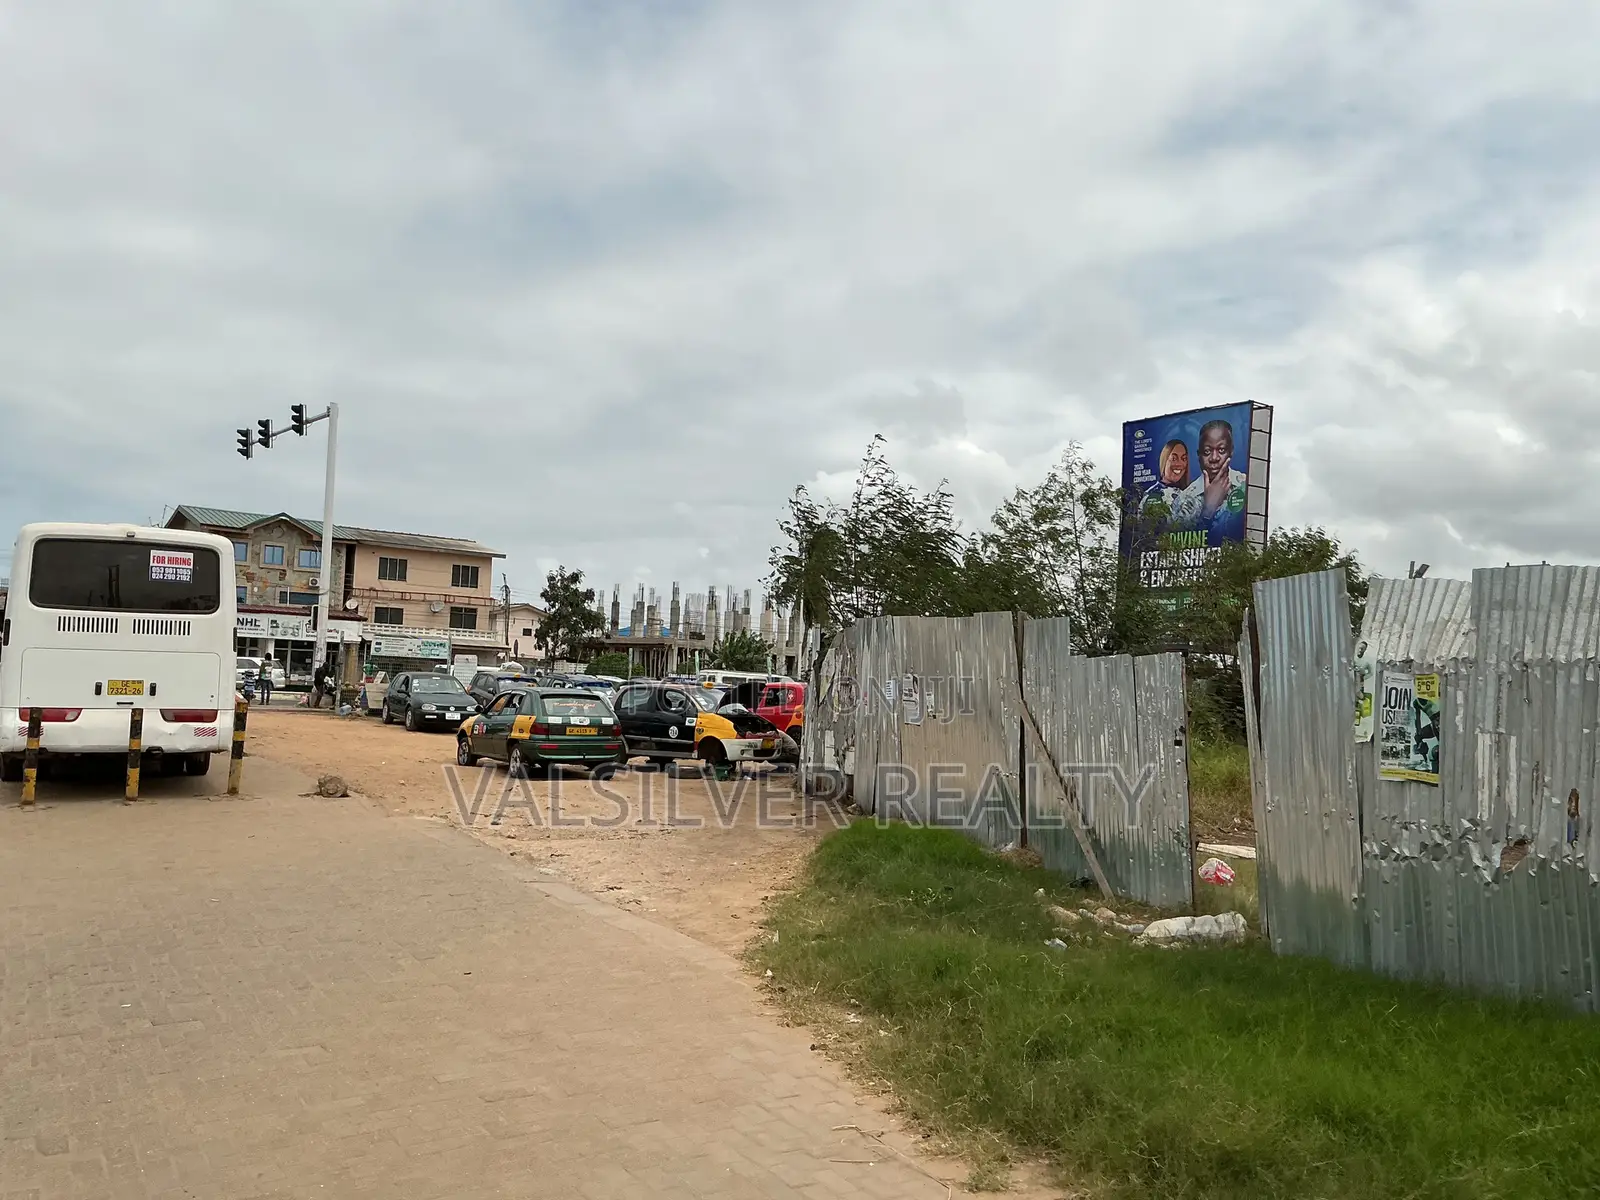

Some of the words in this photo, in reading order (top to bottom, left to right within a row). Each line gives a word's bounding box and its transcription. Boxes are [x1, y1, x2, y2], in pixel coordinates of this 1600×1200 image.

[152, 555, 166, 564] FOR
[167, 556, 192, 567] HIRING
[121, 680, 131, 688] GE
[110, 687, 142, 695] 7321-26
[1382, 685, 1412, 710] JOIN
[1381, 709, 1396, 725] US!
